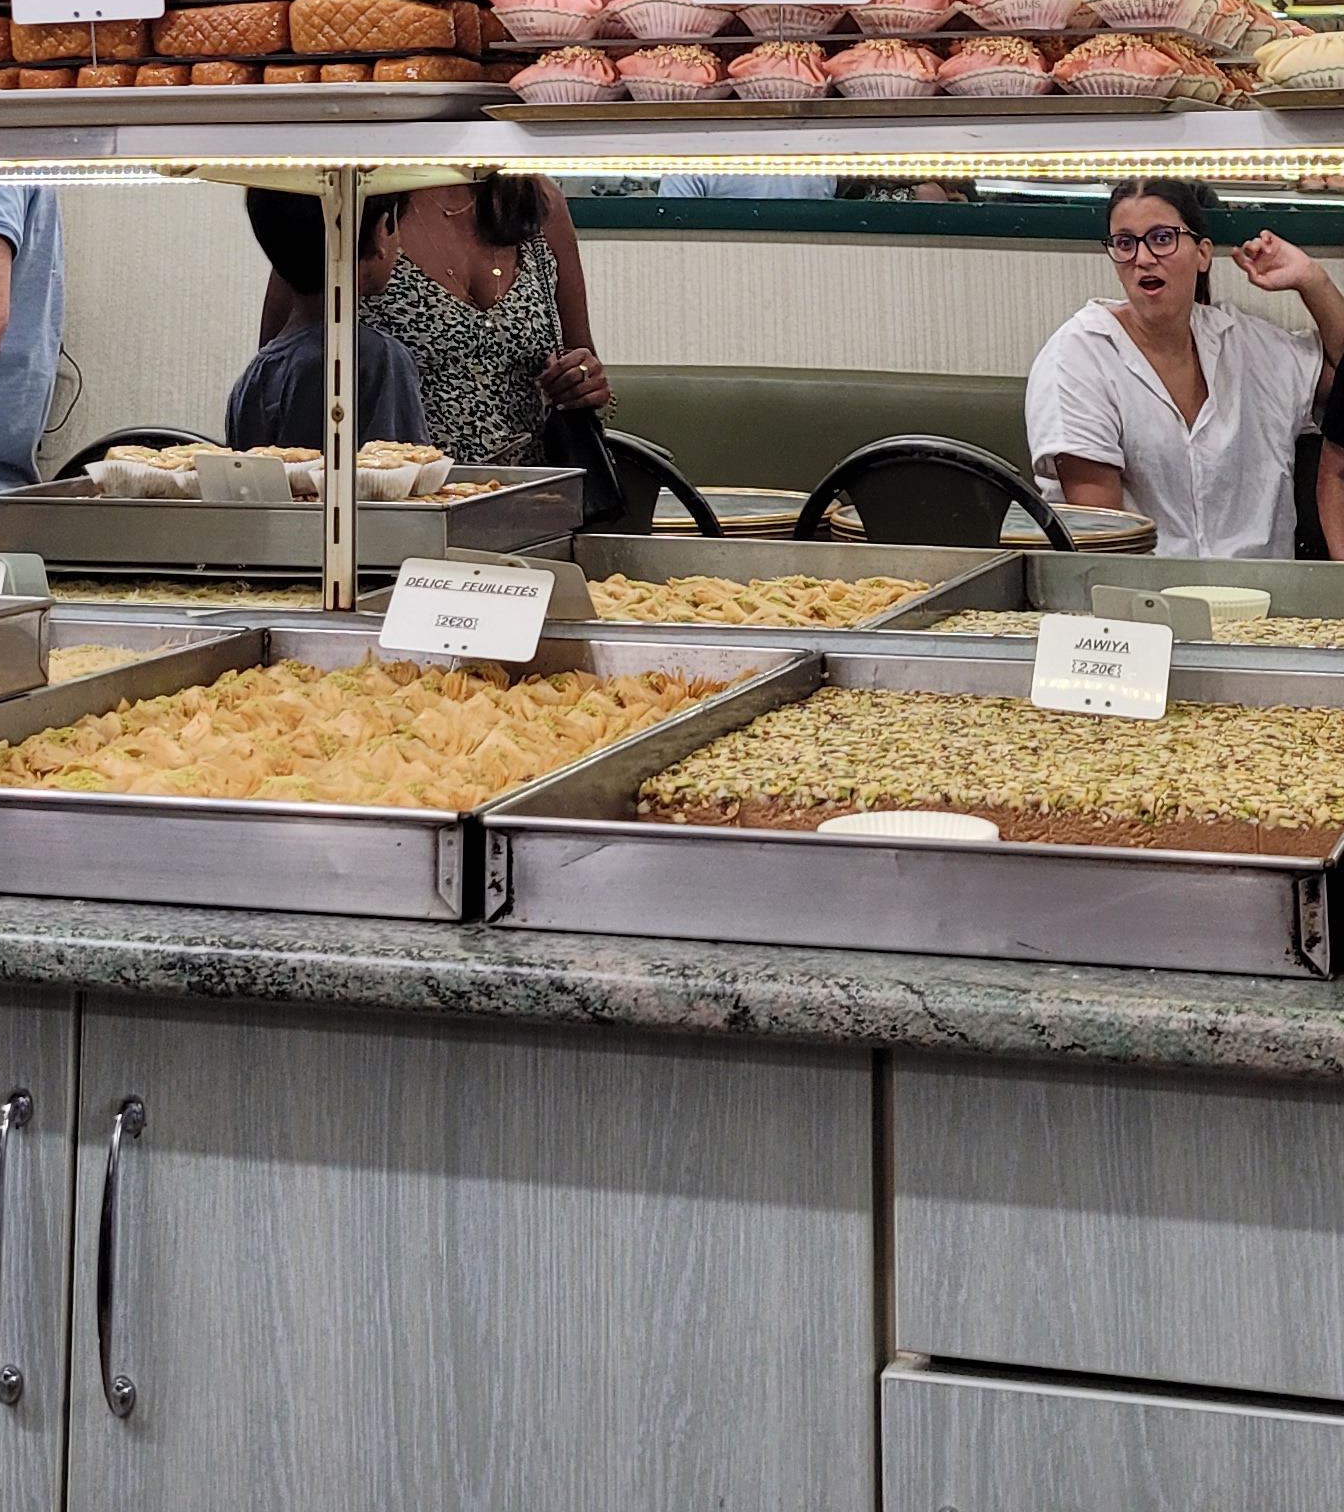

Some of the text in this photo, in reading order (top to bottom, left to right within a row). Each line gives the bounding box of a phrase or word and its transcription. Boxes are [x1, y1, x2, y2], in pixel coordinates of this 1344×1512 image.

[404, 576, 539, 598] DÉLICE FEUILLETÉS
[1074, 637, 1130, 654] JAWIYA
[1077, 661, 1117, 676] 2,20€
